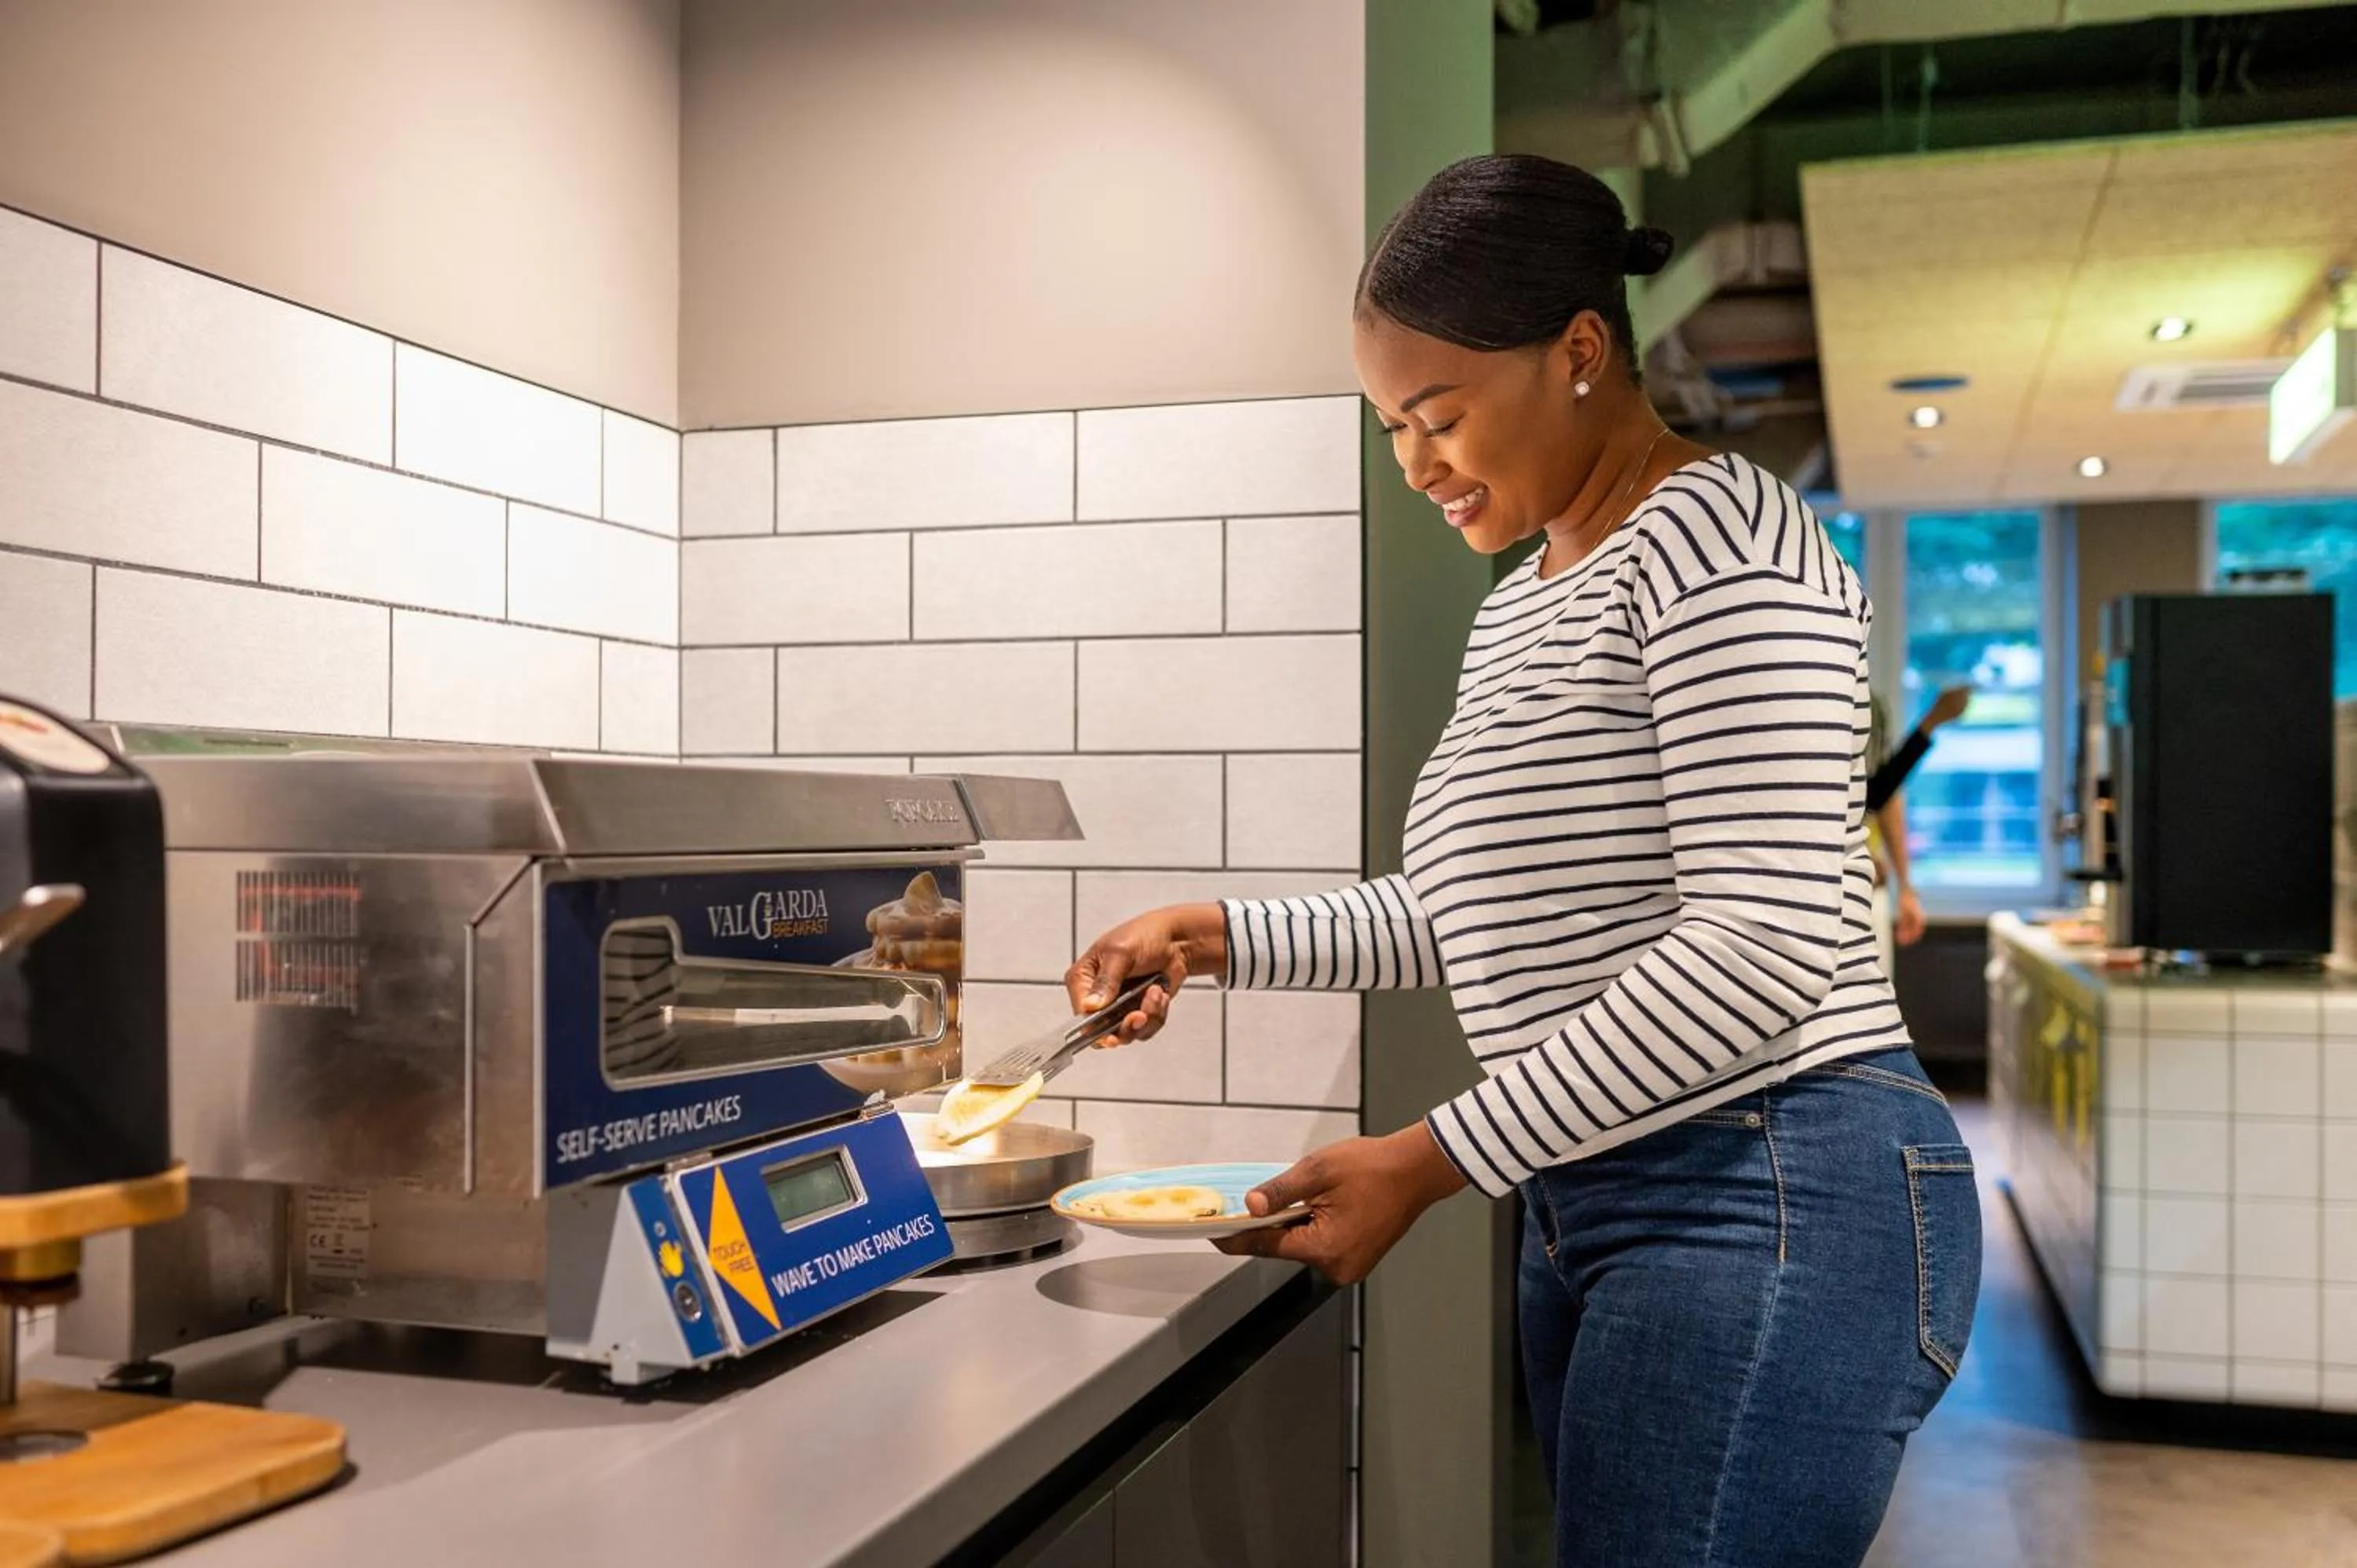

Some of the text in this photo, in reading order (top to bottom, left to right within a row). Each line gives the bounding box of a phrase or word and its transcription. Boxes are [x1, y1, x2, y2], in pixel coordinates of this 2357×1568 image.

[772, 918, 829, 939] BREAKFAST
[556, 1095, 741, 1163] SELF-SERVE PANCAKES
[770, 1214, 935, 1298] WAVE TO MAKE PANCAKES
